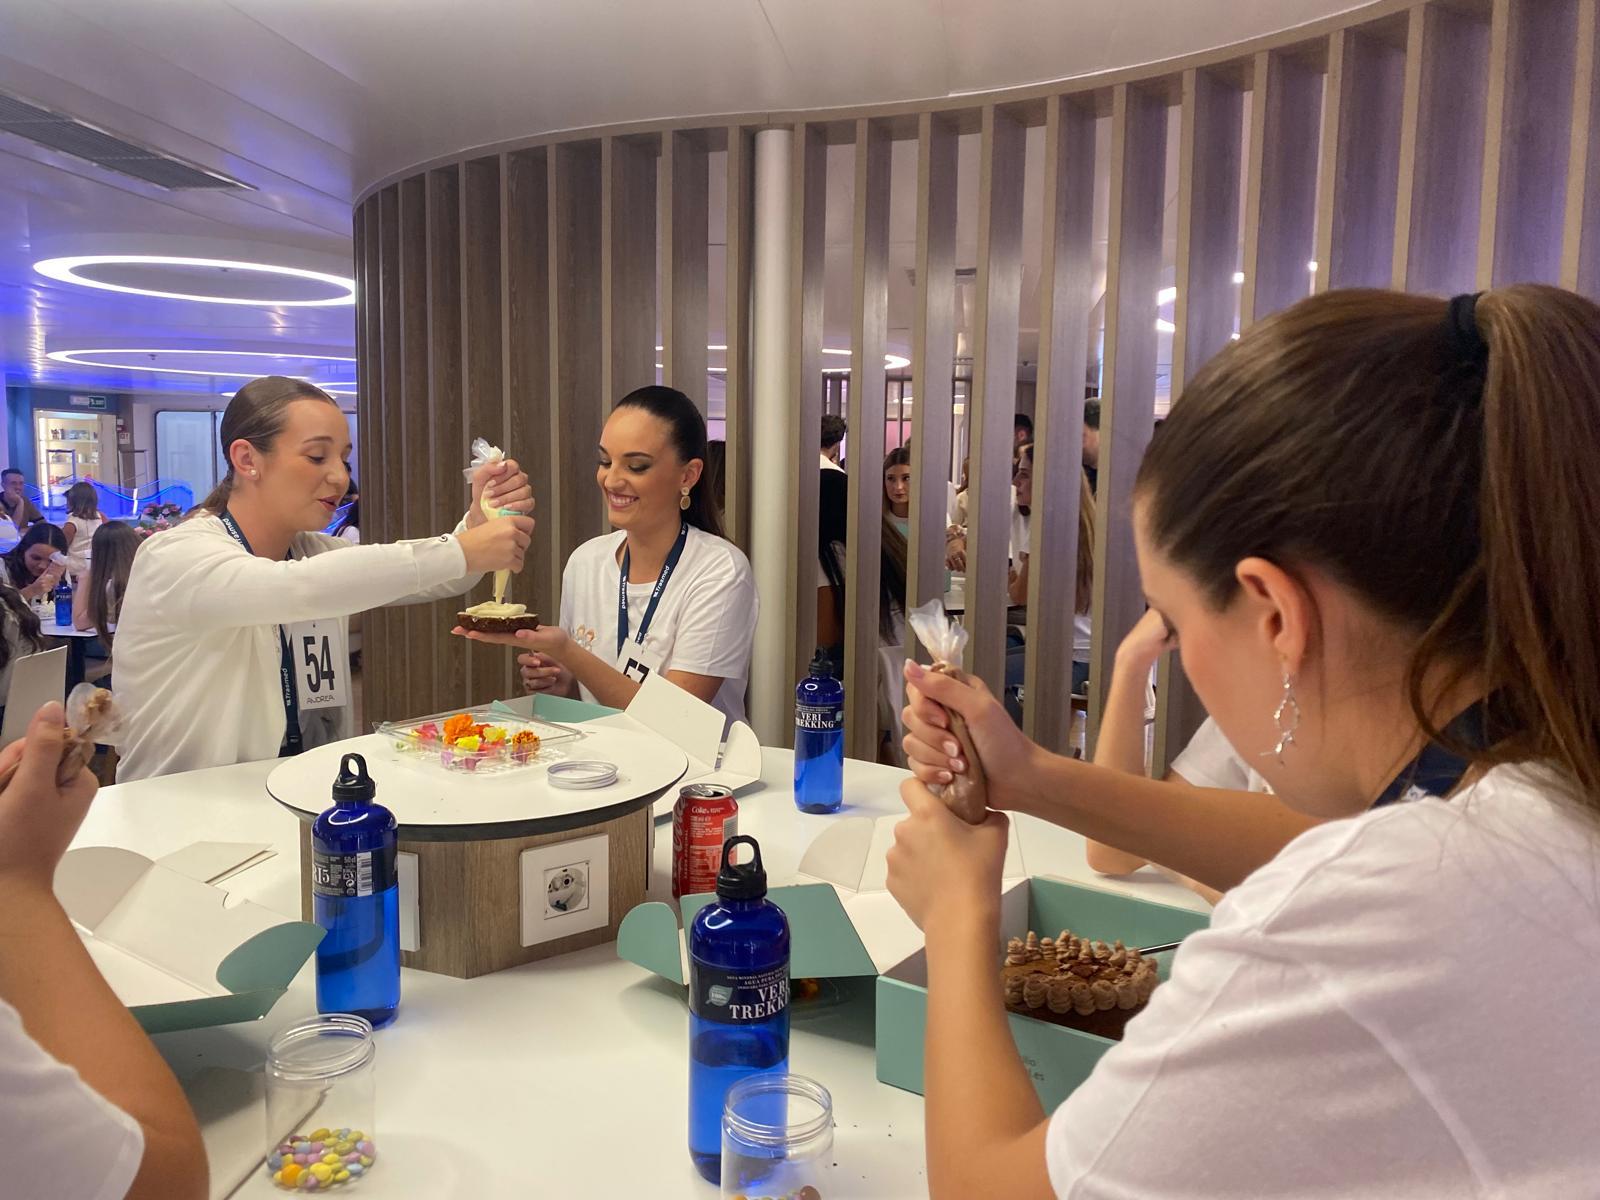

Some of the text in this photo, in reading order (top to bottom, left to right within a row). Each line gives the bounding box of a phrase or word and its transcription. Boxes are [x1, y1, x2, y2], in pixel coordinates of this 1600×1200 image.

[656, 565, 670, 592] Trasmed
[303, 635, 335, 693] 54
[282, 668, 290, 699] Trasmed
[796, 718, 834, 728] REKKING
[802, 712, 821, 721] VERI
[729, 990, 790, 1019] TREKKI
